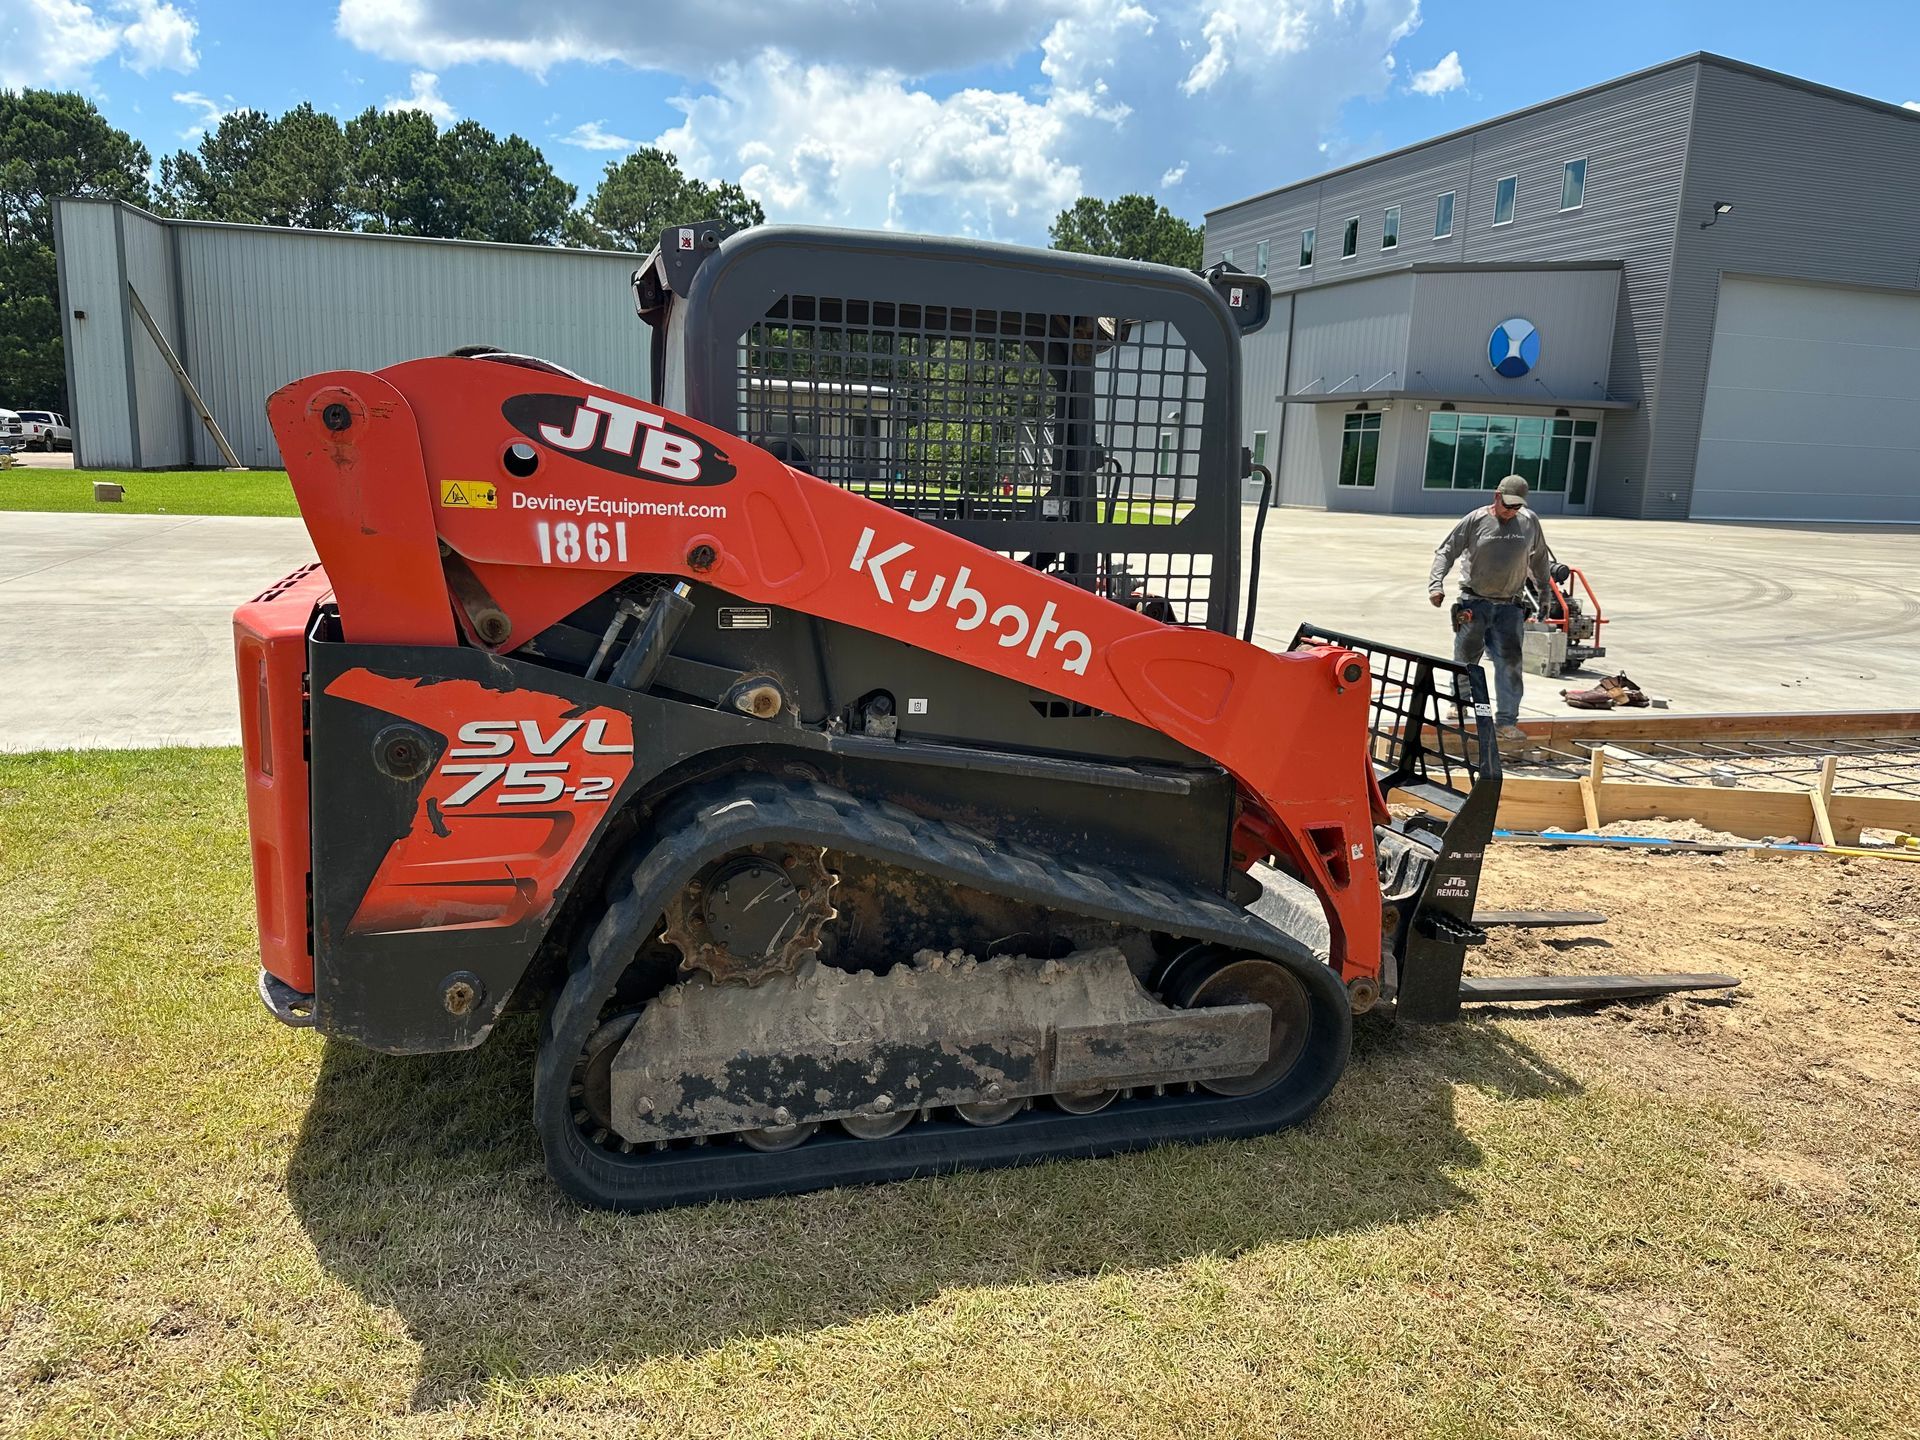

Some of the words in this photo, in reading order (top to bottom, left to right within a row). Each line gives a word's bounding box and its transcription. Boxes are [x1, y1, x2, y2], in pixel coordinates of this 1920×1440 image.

[539, 394, 702, 481] JTB
[511, 491, 727, 519] DevineyEquipment.com
[537, 520, 628, 564] 1861
[849, 526, 1093, 676] Kubota
[450, 719, 634, 758] SVL
[440, 761, 614, 807] 75-2
[1436, 888, 1470, 897] RENTALS
[1444, 877, 1466, 886] JTB
